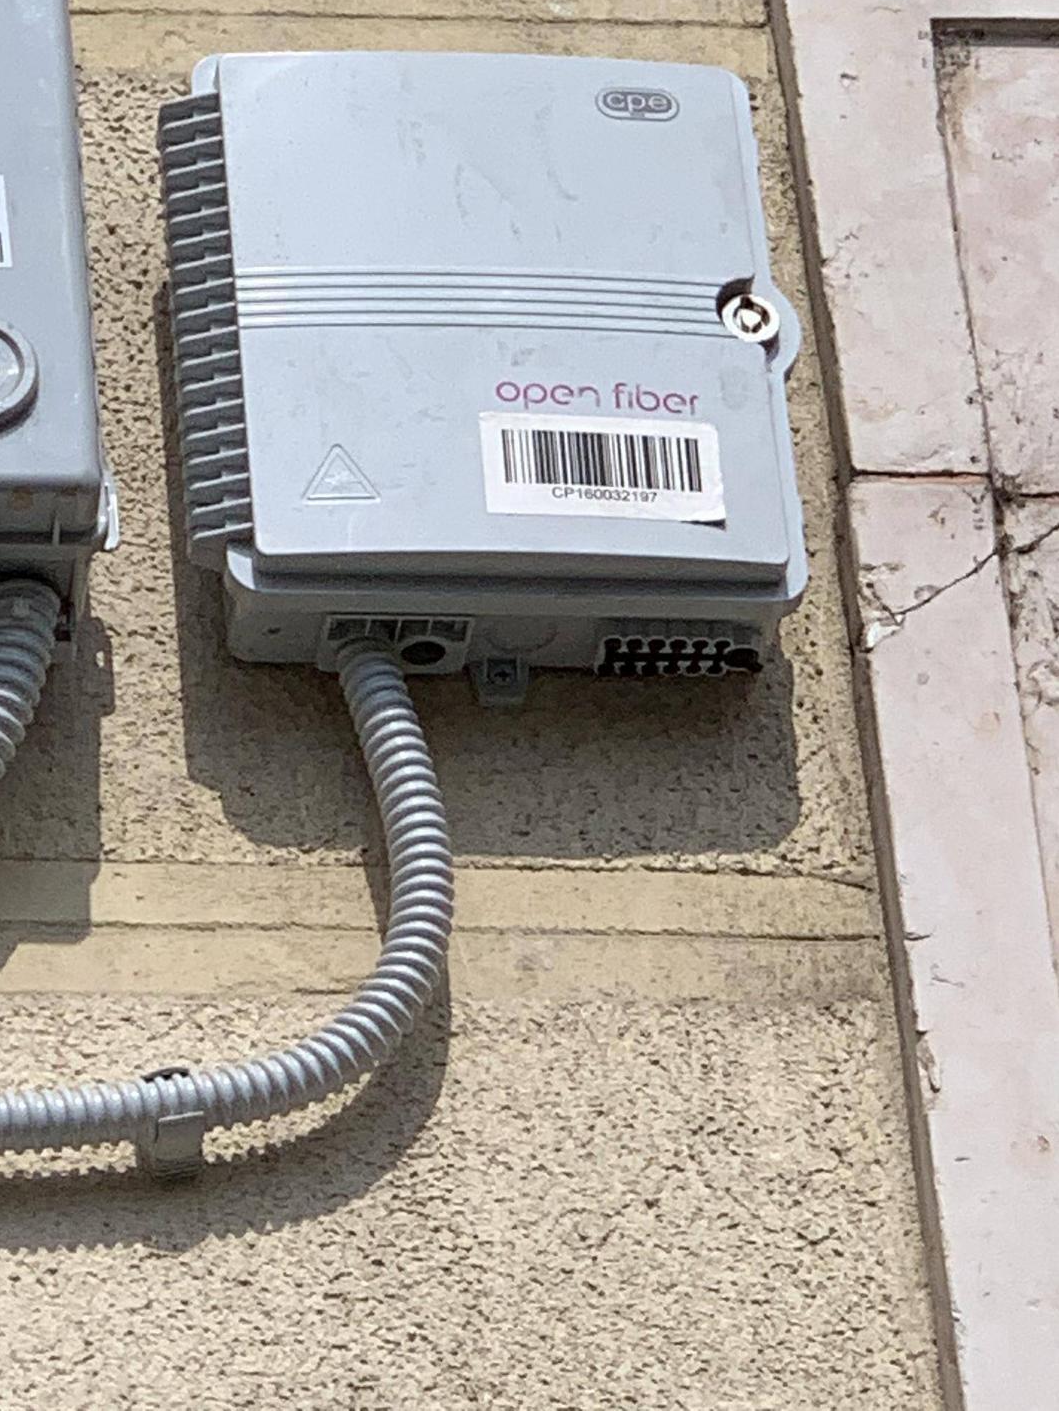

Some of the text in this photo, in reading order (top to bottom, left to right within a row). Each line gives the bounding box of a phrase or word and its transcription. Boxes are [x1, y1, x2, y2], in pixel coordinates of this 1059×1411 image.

[496, 381, 699, 415] open fiber
[552, 486, 658, 503] CP160032197
